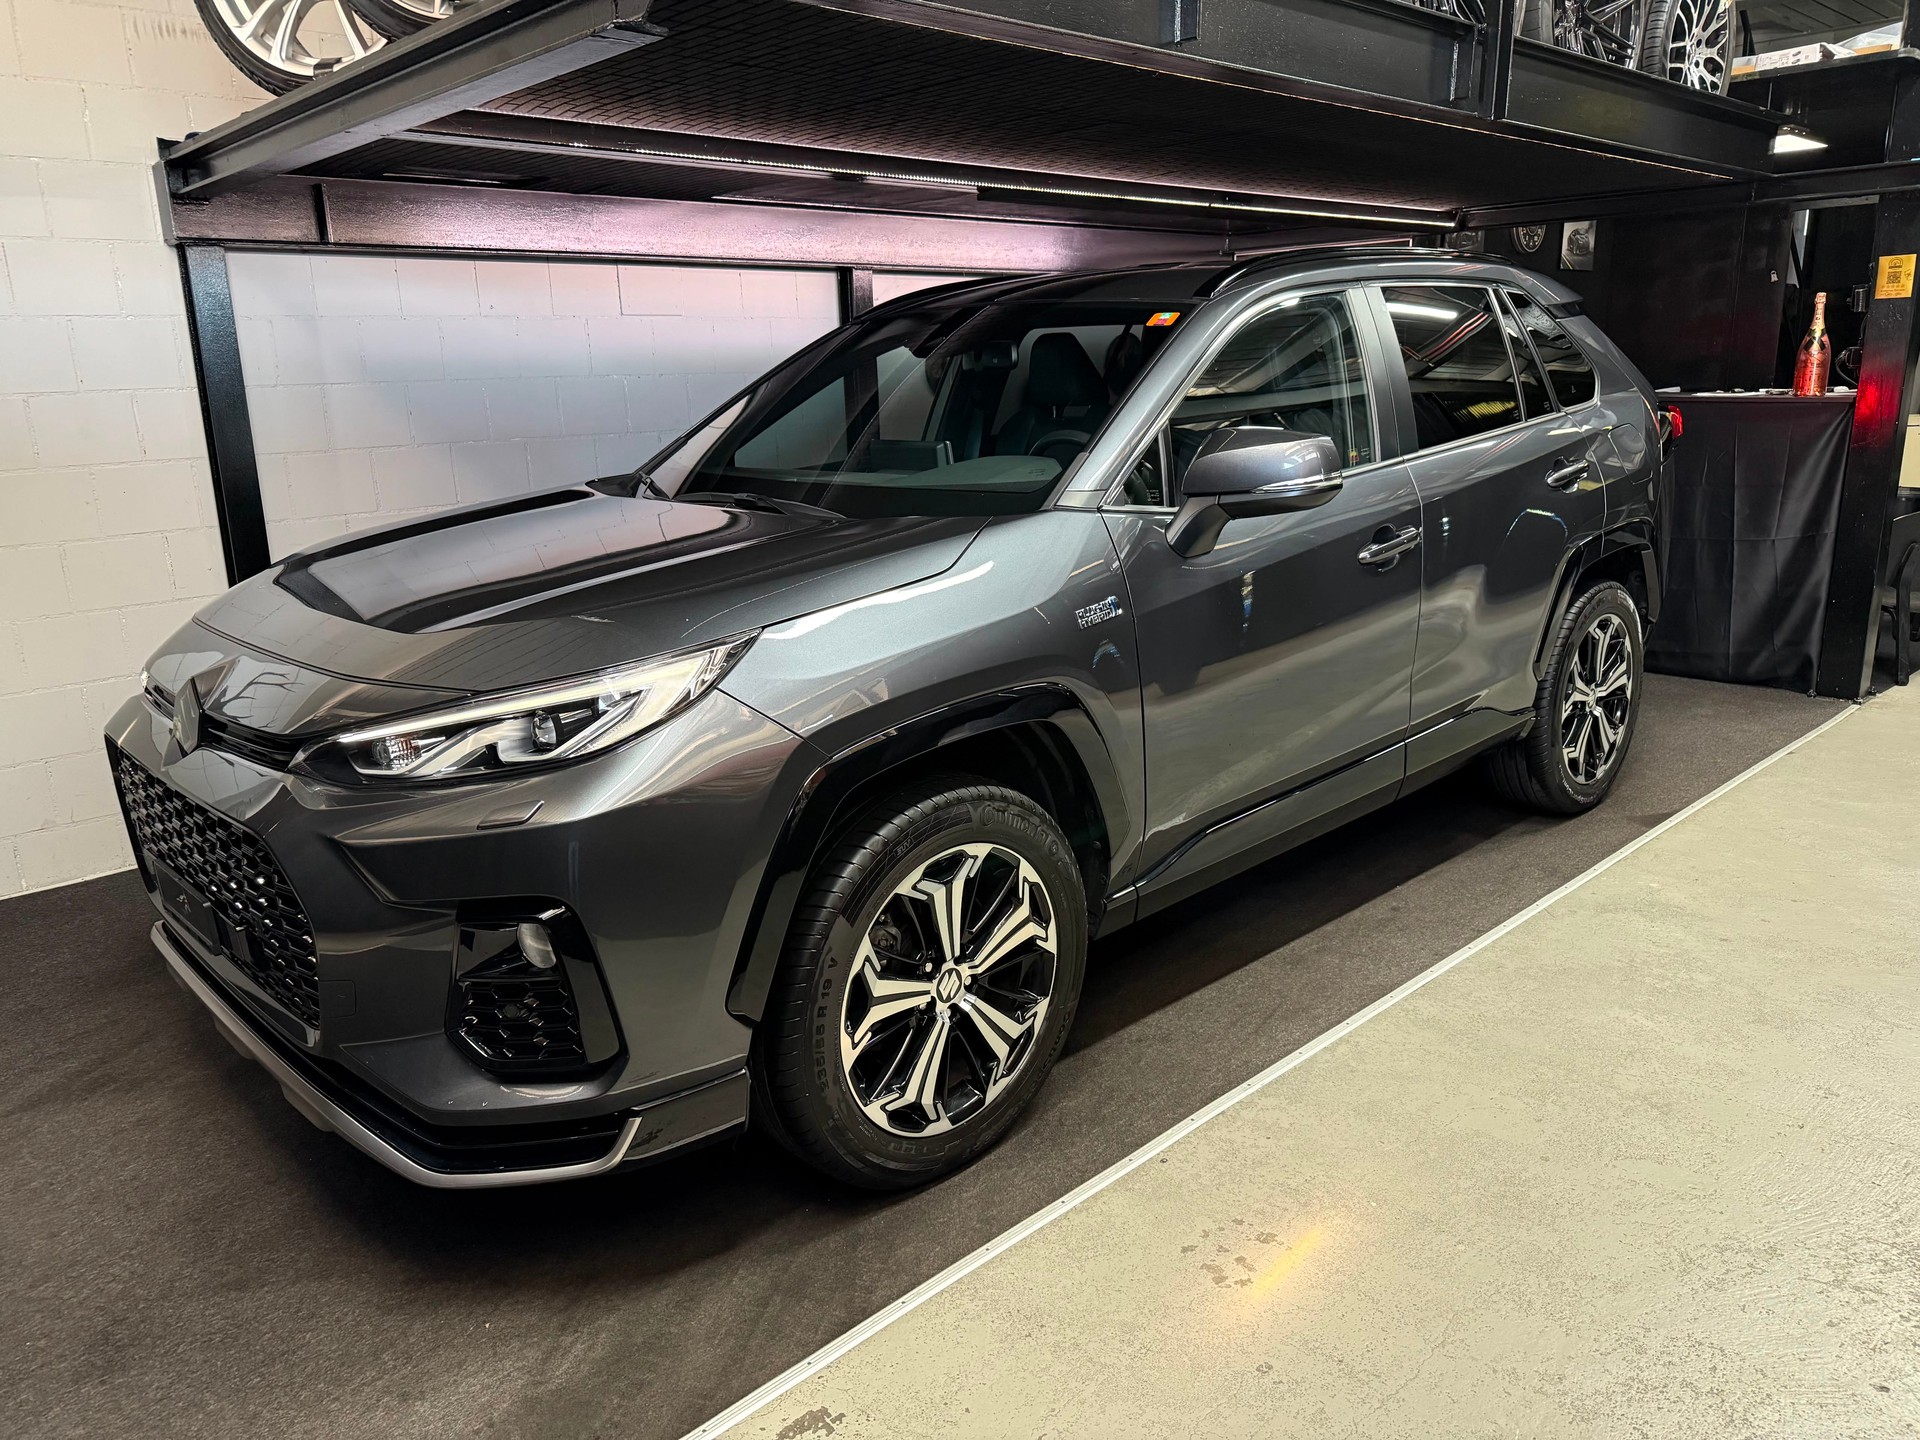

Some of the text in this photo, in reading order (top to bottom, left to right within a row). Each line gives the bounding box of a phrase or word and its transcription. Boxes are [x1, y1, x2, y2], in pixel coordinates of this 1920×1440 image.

[1079, 608, 1113, 629] HYBRID
[895, 837, 912, 855] SUV
[827, 956, 838, 970] V
[821, 978, 833, 999] 19
[817, 1005, 828, 1018] R
[815, 1022, 830, 1093] 235/55
